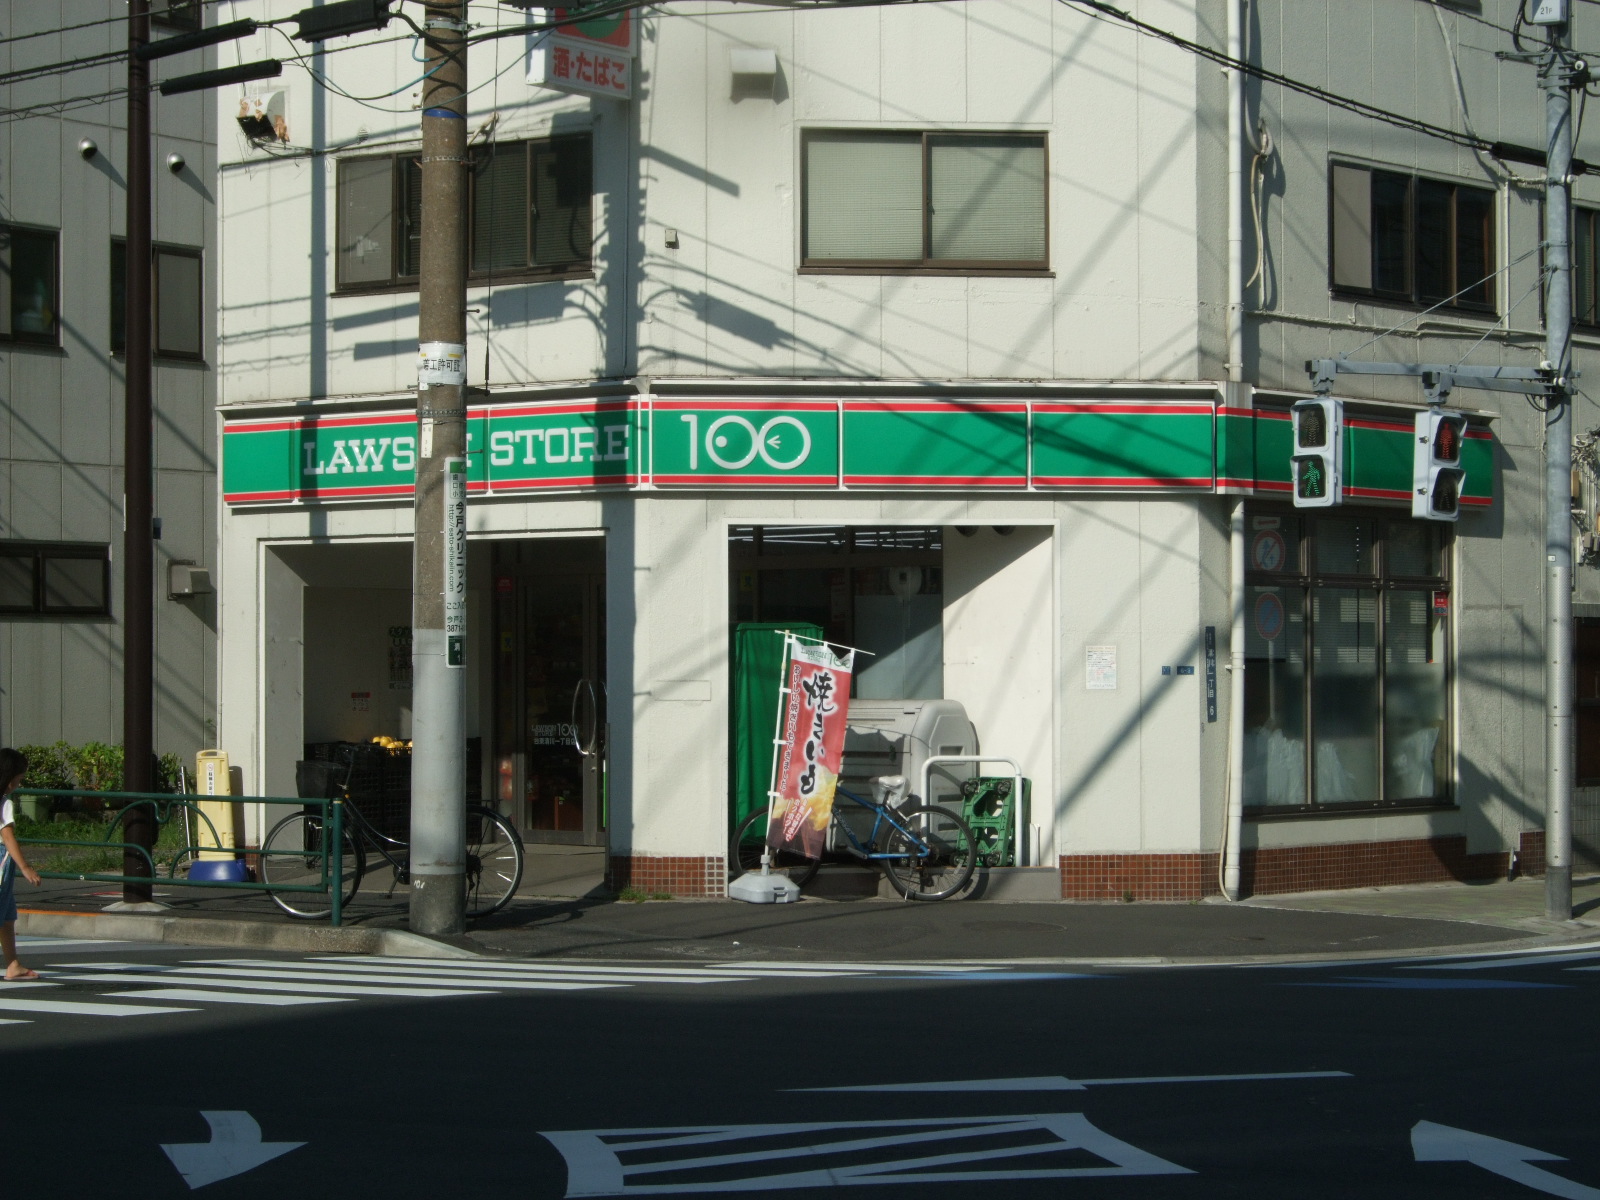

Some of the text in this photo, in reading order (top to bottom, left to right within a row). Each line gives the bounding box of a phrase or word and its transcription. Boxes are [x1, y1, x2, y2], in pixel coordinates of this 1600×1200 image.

[553, 46, 625, 90] 酒・たばこ
[303, 433, 472, 476] LAWS
[491, 425, 629, 467] STORE
[680, 413, 812, 471] 100
[456, 501, 465, 594] 今戸クリニック
[801, 671, 835, 795] 焼きいも
